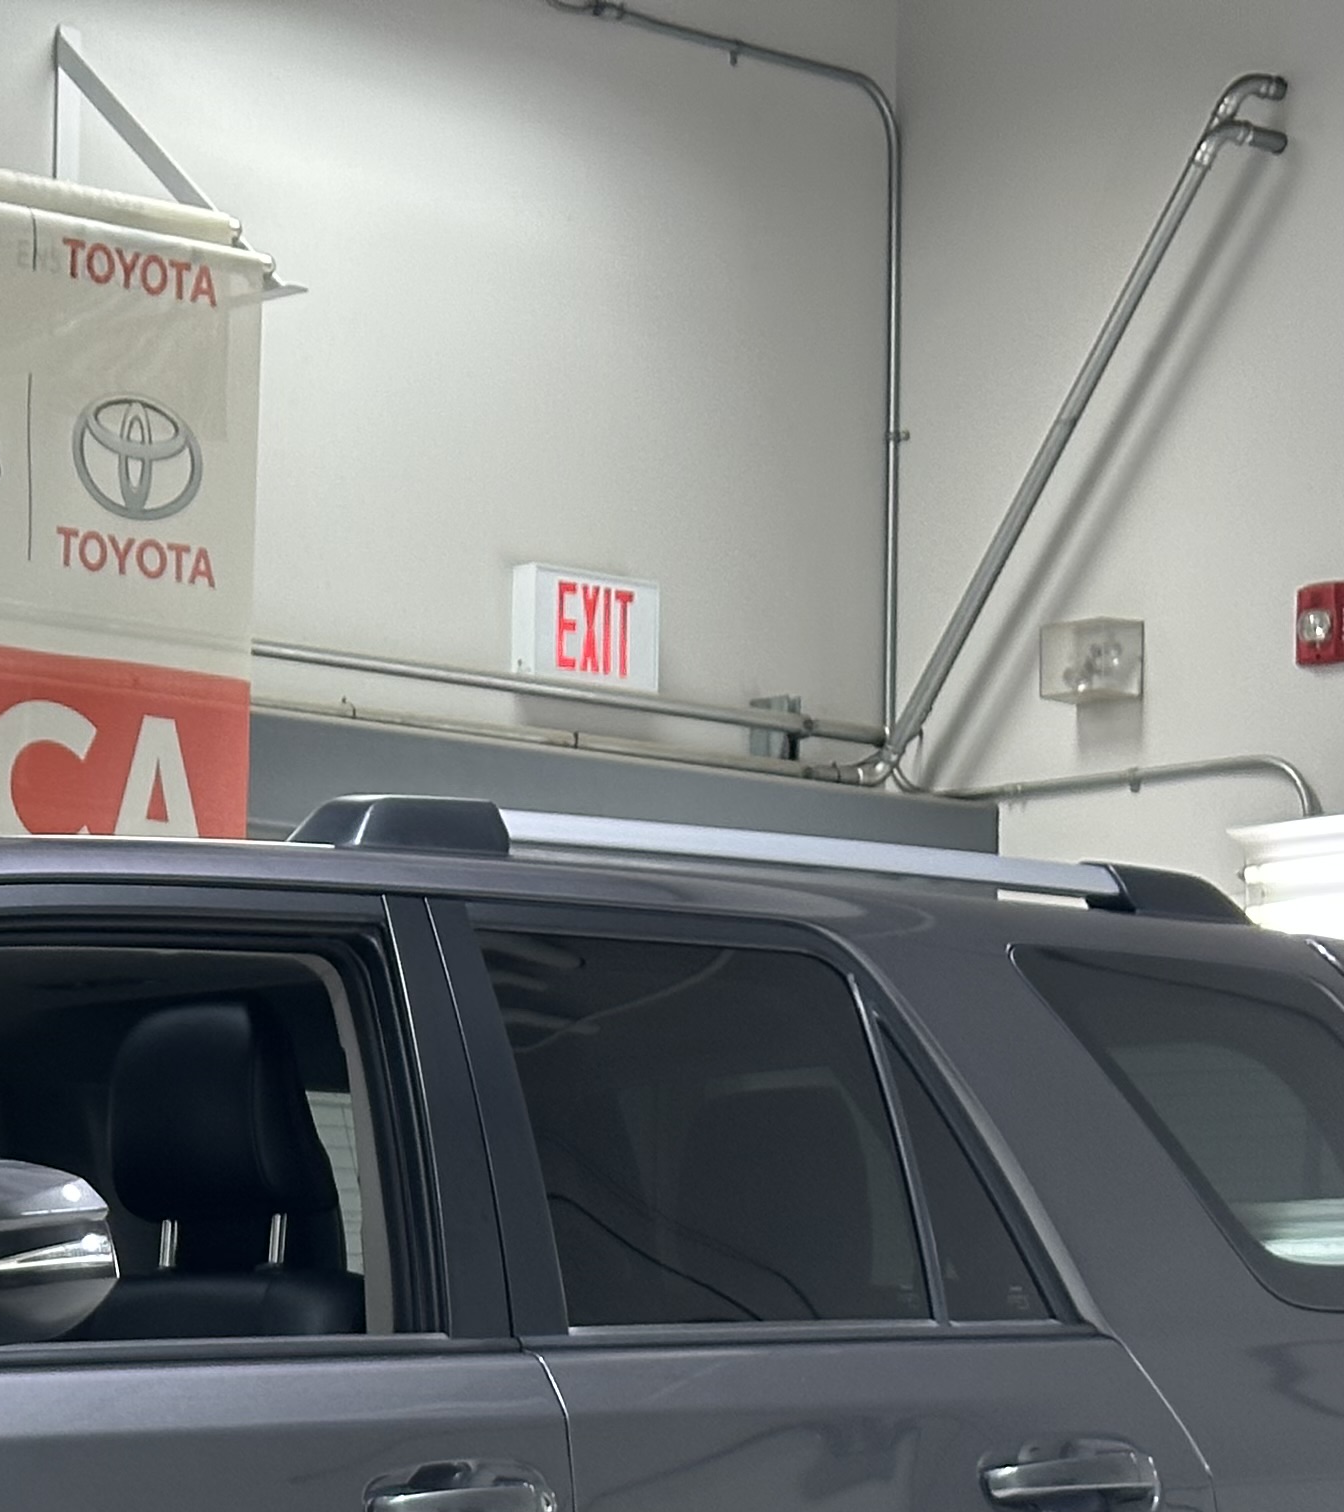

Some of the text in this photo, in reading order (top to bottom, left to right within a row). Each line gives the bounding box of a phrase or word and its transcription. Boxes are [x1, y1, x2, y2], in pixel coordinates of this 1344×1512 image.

[63, 238, 217, 306] TOYOTA
[57, 527, 215, 587] TOYOTA
[554, 580, 635, 679] EXIT
